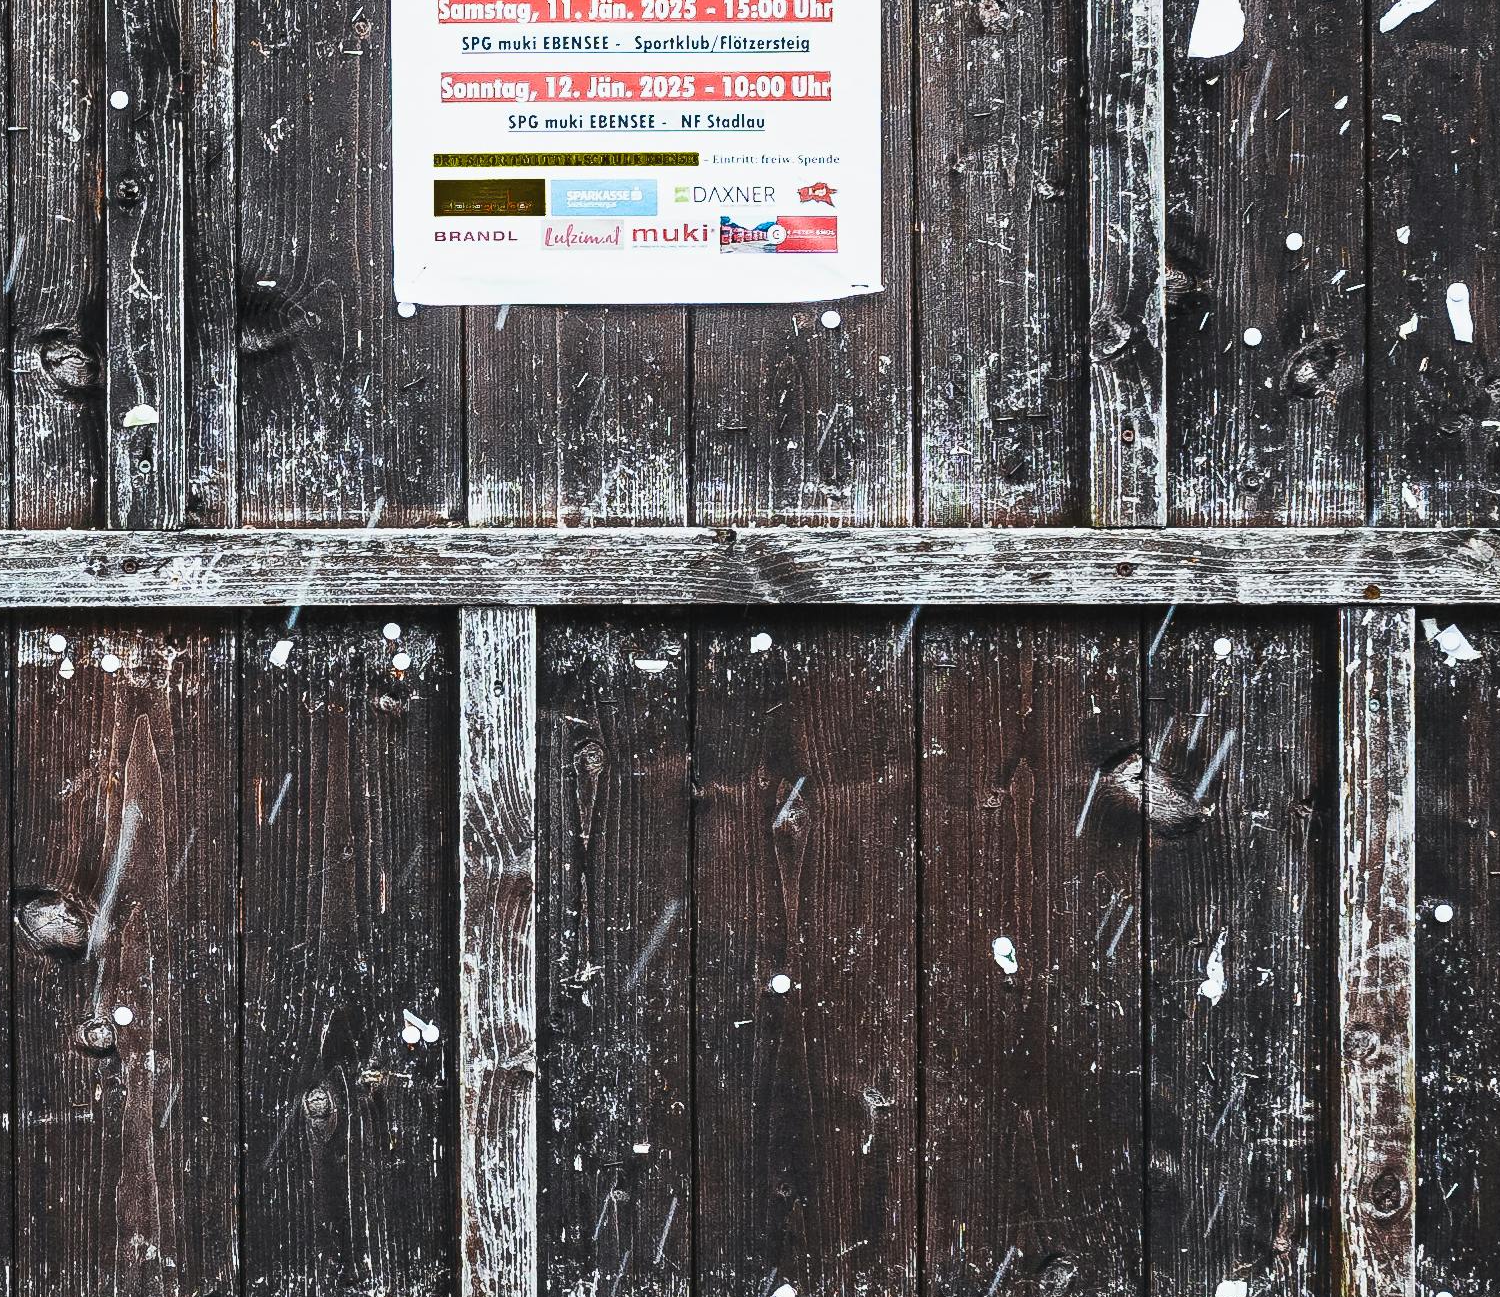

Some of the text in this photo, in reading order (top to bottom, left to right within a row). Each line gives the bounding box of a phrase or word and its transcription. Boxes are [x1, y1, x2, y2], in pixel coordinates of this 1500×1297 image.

[462, 36, 493, 51] SPG
[498, 35, 537, 51] muki
[543, 36, 609, 50] EBENSEE
[634, 34, 810, 52] Sportklub/Flötzersteig
[440, 76, 539, 102] Sonntag,
[545, 76, 581, 98] 12.
[586, 76, 633, 98] Jän.
[639, 75, 696, 98] 2025
[722, 75, 786, 98] 10:00
[791, 74, 832, 98] Uhr
[508, 114, 539, 129] SPG
[544, 113, 583, 129] muki
[590, 114, 655, 129] EBENSEE
[681, 114, 701, 129] NF
[707, 113, 765, 129] Stadlau
[797, 154, 840, 167] Spende
[567, 189, 630, 202] SPARKASSE
[693, 186, 775, 203] DAXNER
[434, 230, 519, 242] BRANDL
[632, 223, 708, 242] muki
